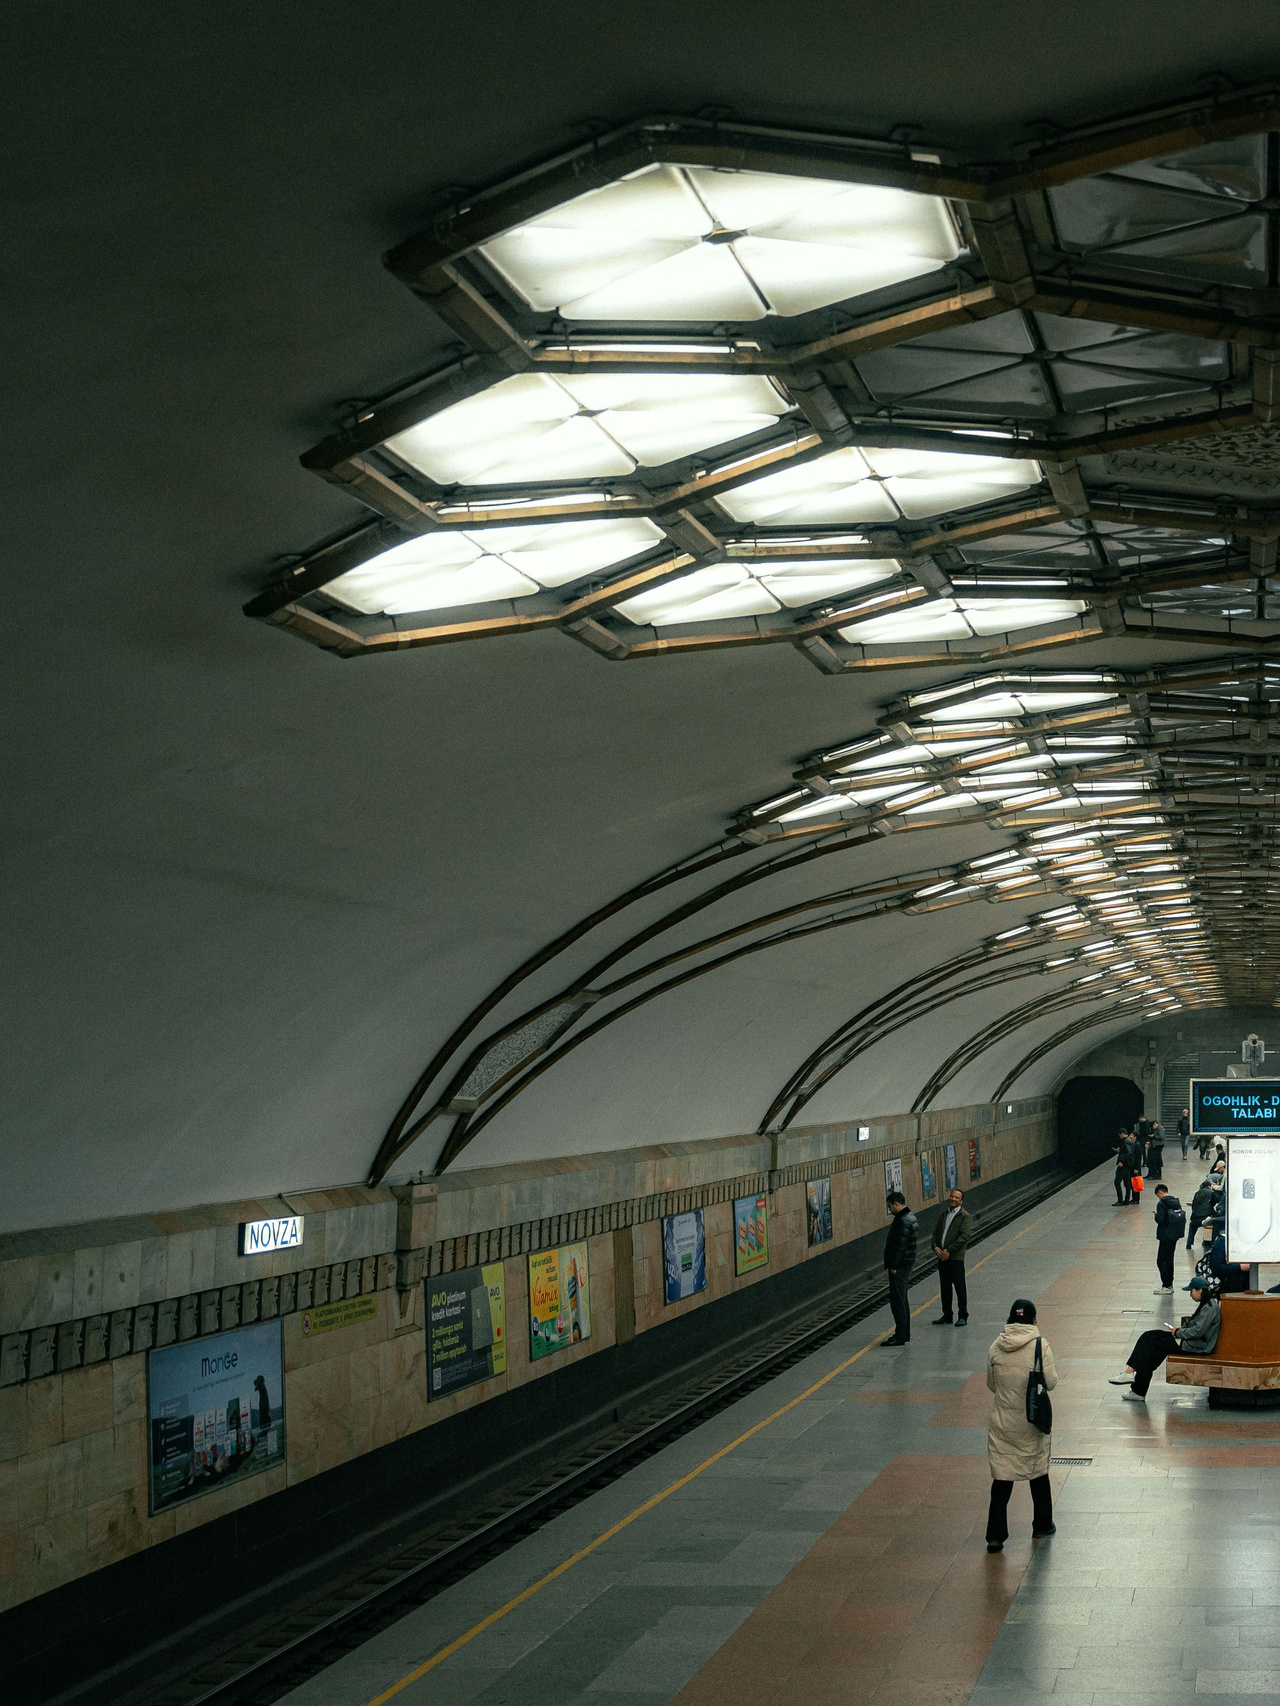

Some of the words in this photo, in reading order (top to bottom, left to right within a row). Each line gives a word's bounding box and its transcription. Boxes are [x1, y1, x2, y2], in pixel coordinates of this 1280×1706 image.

[1202, 1096, 1260, 1106] OGOHLIK
[1231, 1108, 1277, 1118] TALABI
[250, 1219, 298, 1249] NOVZA
[431, 1291, 446, 1308] AVO
[447, 1291, 466, 1306] platinum
[532, 1277, 558, 1307] Vitamix
[431, 1308, 445, 1321] kredit
[446, 1303, 461, 1317] kartasi
